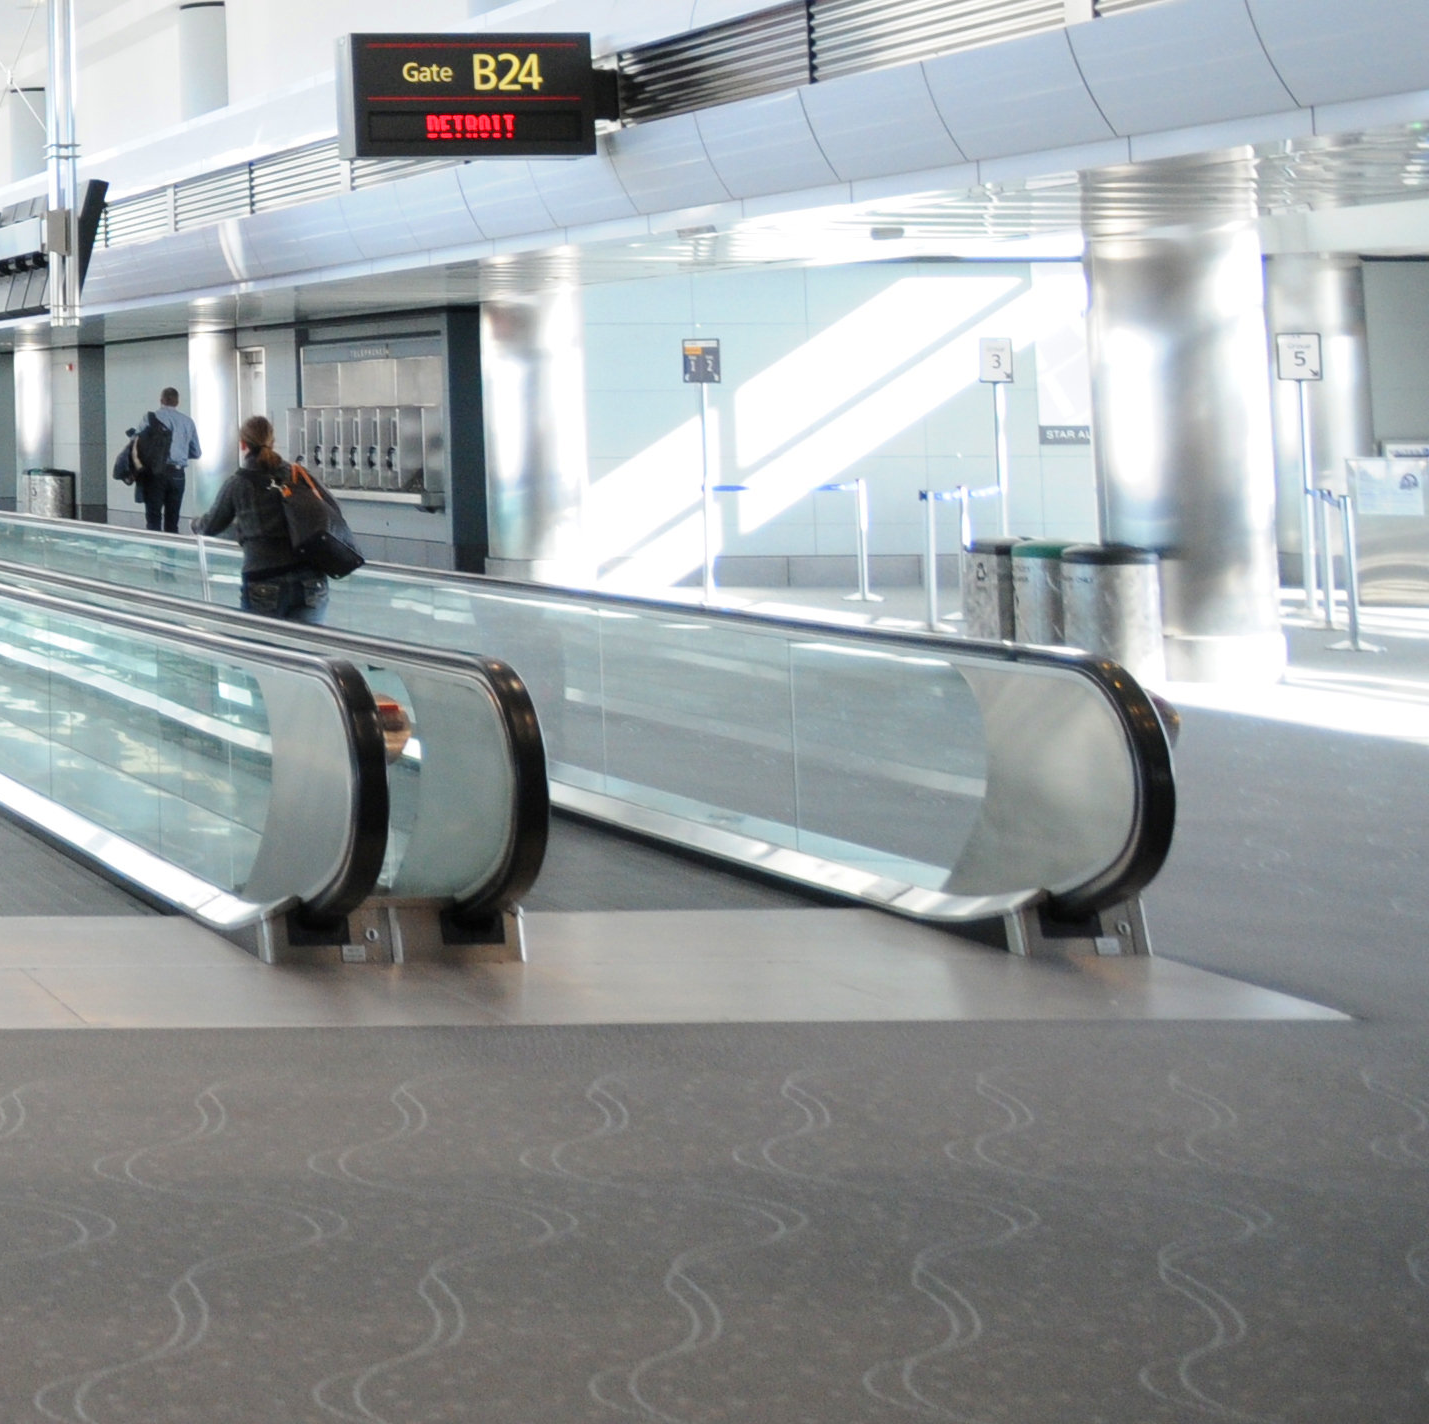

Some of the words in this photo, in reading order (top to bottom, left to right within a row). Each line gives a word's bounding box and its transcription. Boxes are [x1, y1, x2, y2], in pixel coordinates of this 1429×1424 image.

[402, 62, 453, 82] Gate
[473, 53, 543, 90] B24
[426, 114, 515, 139] DETROIT
[991, 354, 1001, 369] 3
[1294, 351, 1306, 367] 5
[1046, 430, 1075, 440] STAR
